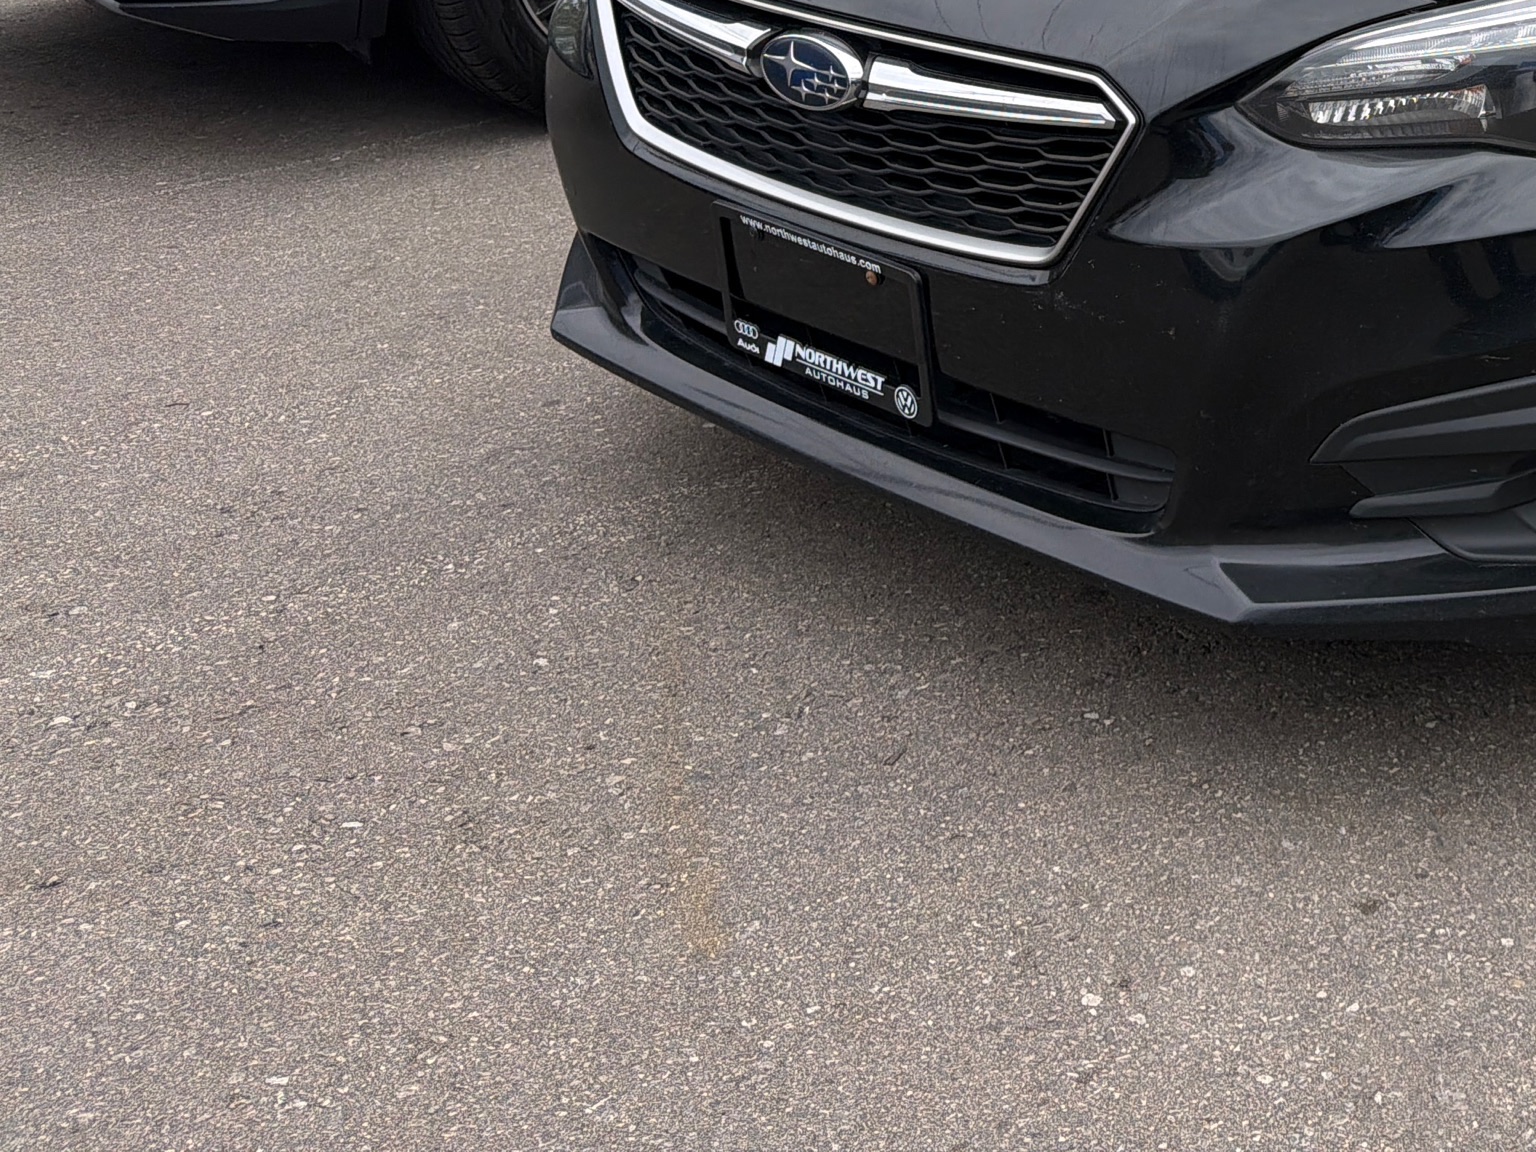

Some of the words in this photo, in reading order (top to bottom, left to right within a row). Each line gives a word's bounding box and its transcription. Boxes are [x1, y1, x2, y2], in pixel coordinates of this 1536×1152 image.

[740, 214, 882, 274] www.northwestautohaus.com
[737, 338, 760, 354] Audi
[795, 343, 885, 391] NORTHWEST
[805, 367, 869, 400] AUTOHAUS
